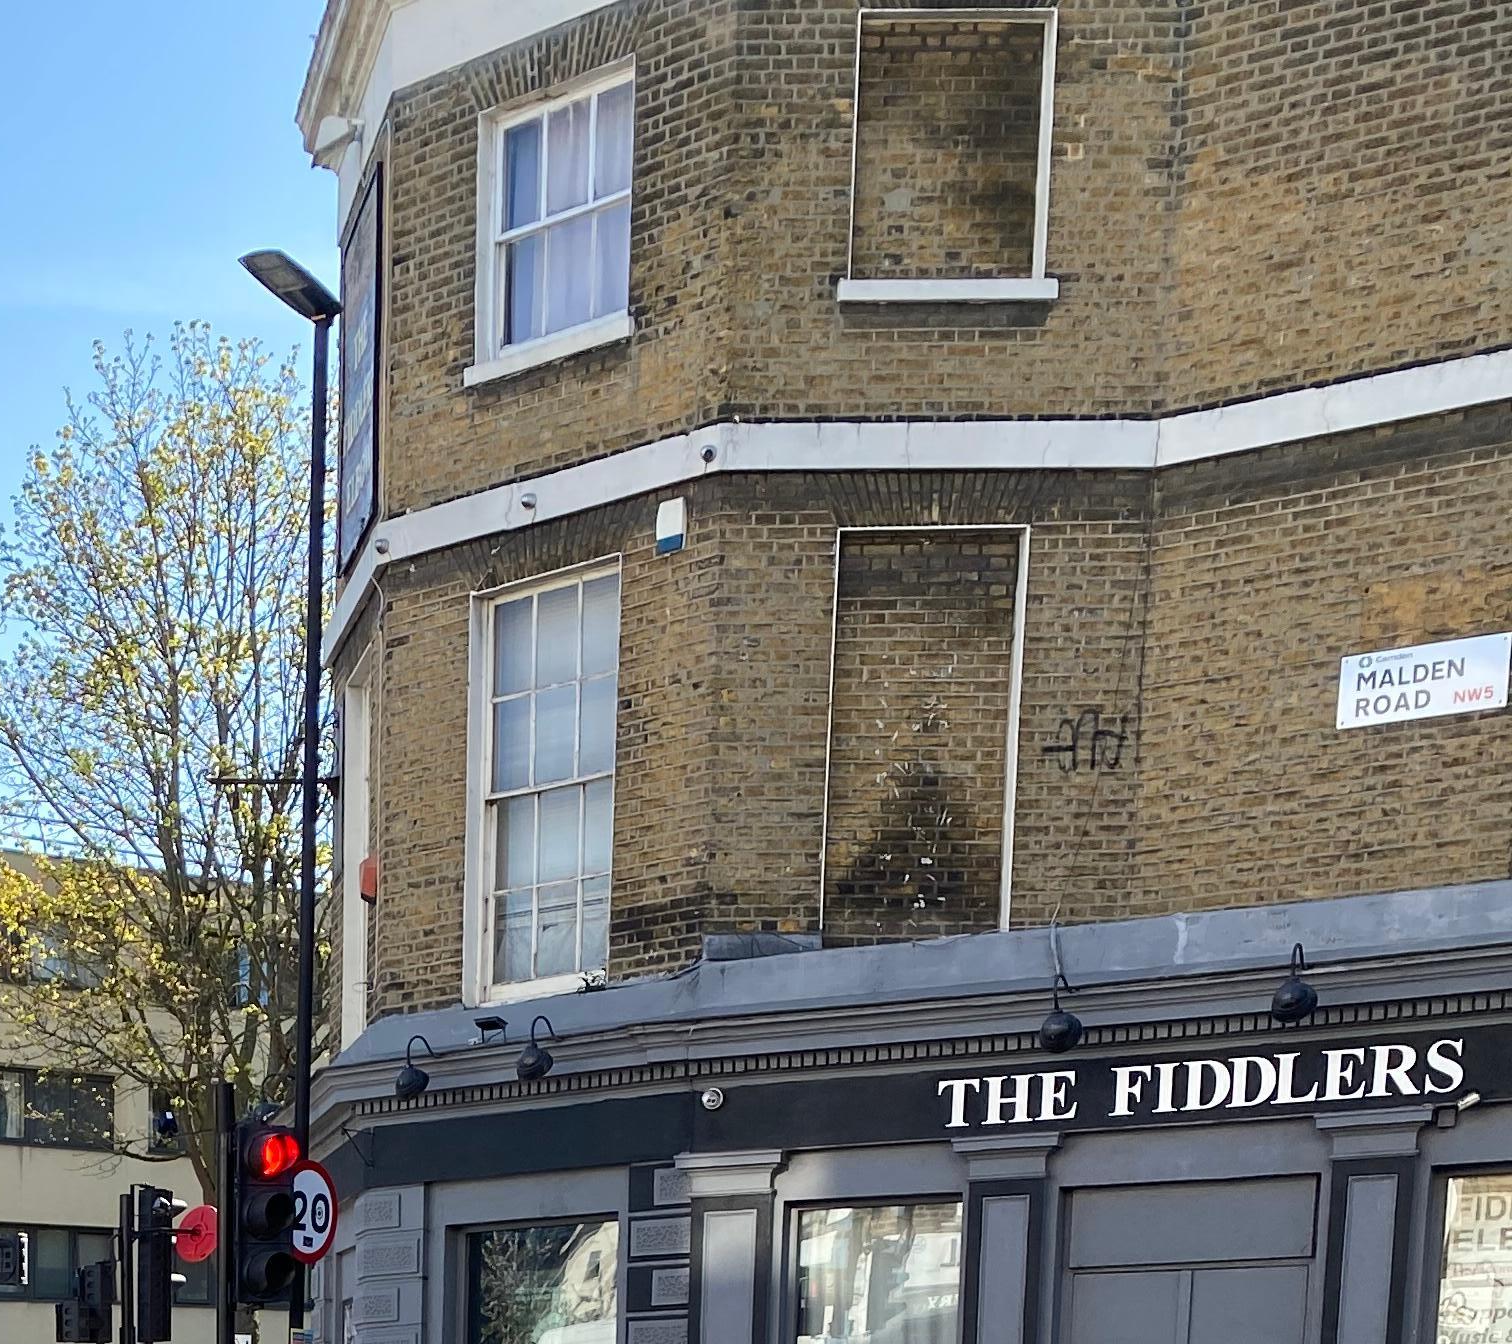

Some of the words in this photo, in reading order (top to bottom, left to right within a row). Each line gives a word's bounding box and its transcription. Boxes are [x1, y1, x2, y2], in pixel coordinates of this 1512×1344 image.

[1356, 657, 1465, 691] MALDEN
[1376, 653, 1414, 664] Camden
[1355, 689, 1431, 717] ROAD
[1453, 686, 1494, 704] NW5
[937, 1070, 1079, 1128] THE
[1108, 1039, 1465, 1118] FIDDLERS
[292, 1190, 330, 1234] 20
[1459, 1195, 1512, 1222] FID
